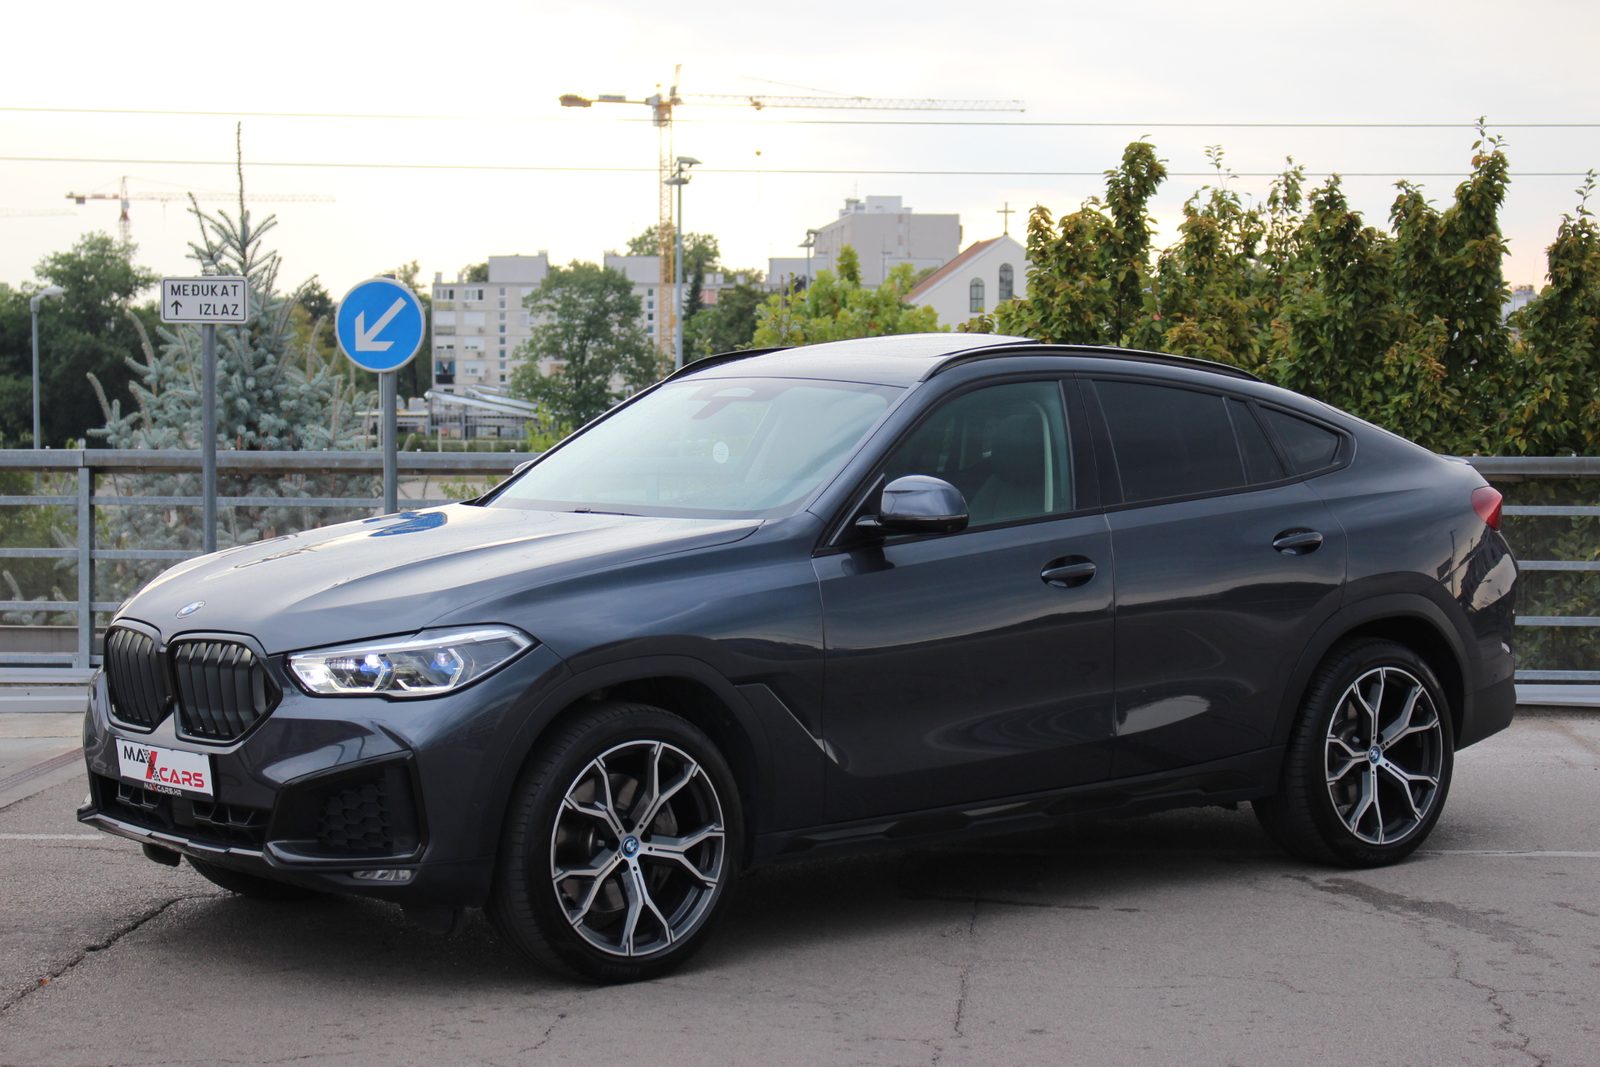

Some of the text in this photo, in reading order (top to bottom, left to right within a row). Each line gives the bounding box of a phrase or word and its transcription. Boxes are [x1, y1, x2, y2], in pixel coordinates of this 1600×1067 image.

[170, 284, 239, 297] MEĐUKAT
[199, 303, 239, 316] IZLAZ
[159, 766, 204, 788] CARS
